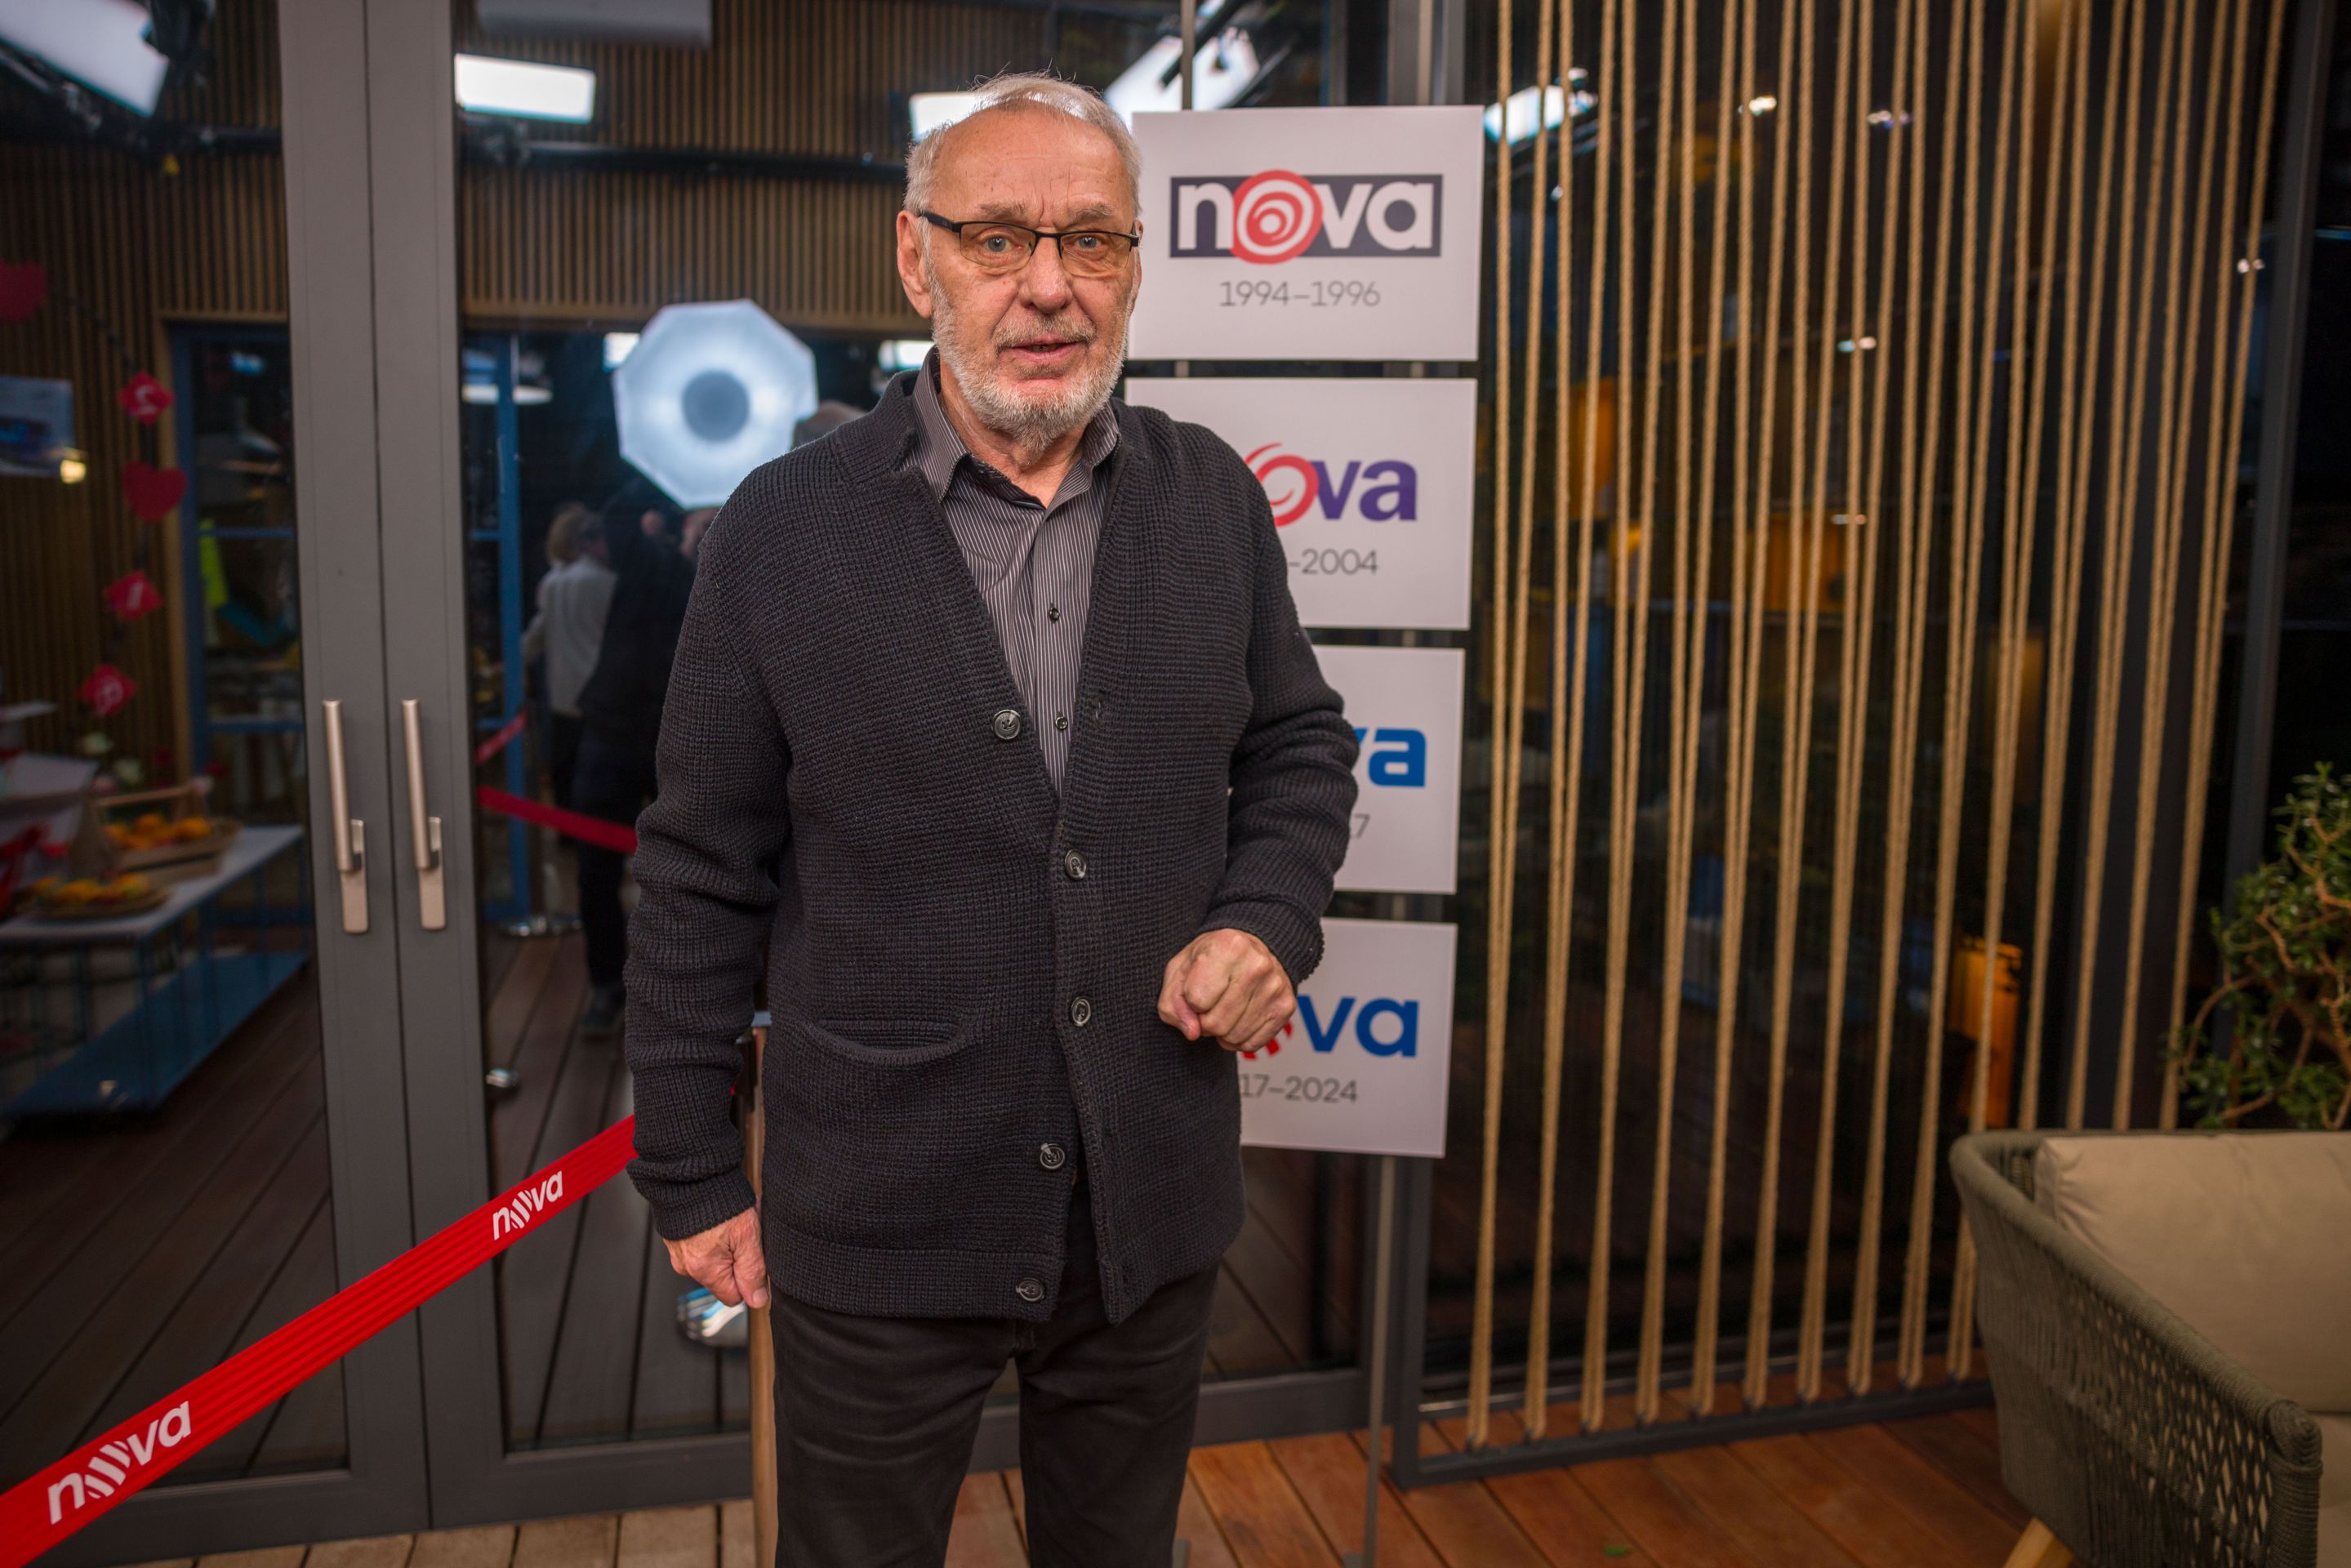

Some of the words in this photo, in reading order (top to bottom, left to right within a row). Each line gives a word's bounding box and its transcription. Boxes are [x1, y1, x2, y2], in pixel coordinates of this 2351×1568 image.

[1178, 170, 1435, 265] nova
[1219, 280, 1381, 307] 1994–1996
[1245, 443, 1418, 528] ova
[1288, 548, 1378, 575] –2004
[1241, 994, 1420, 1058] va
[1239, 1072, 1358, 1103] 17–2024
[492, 1170, 563, 1241] nova
[47, 1400, 192, 1526] nova
